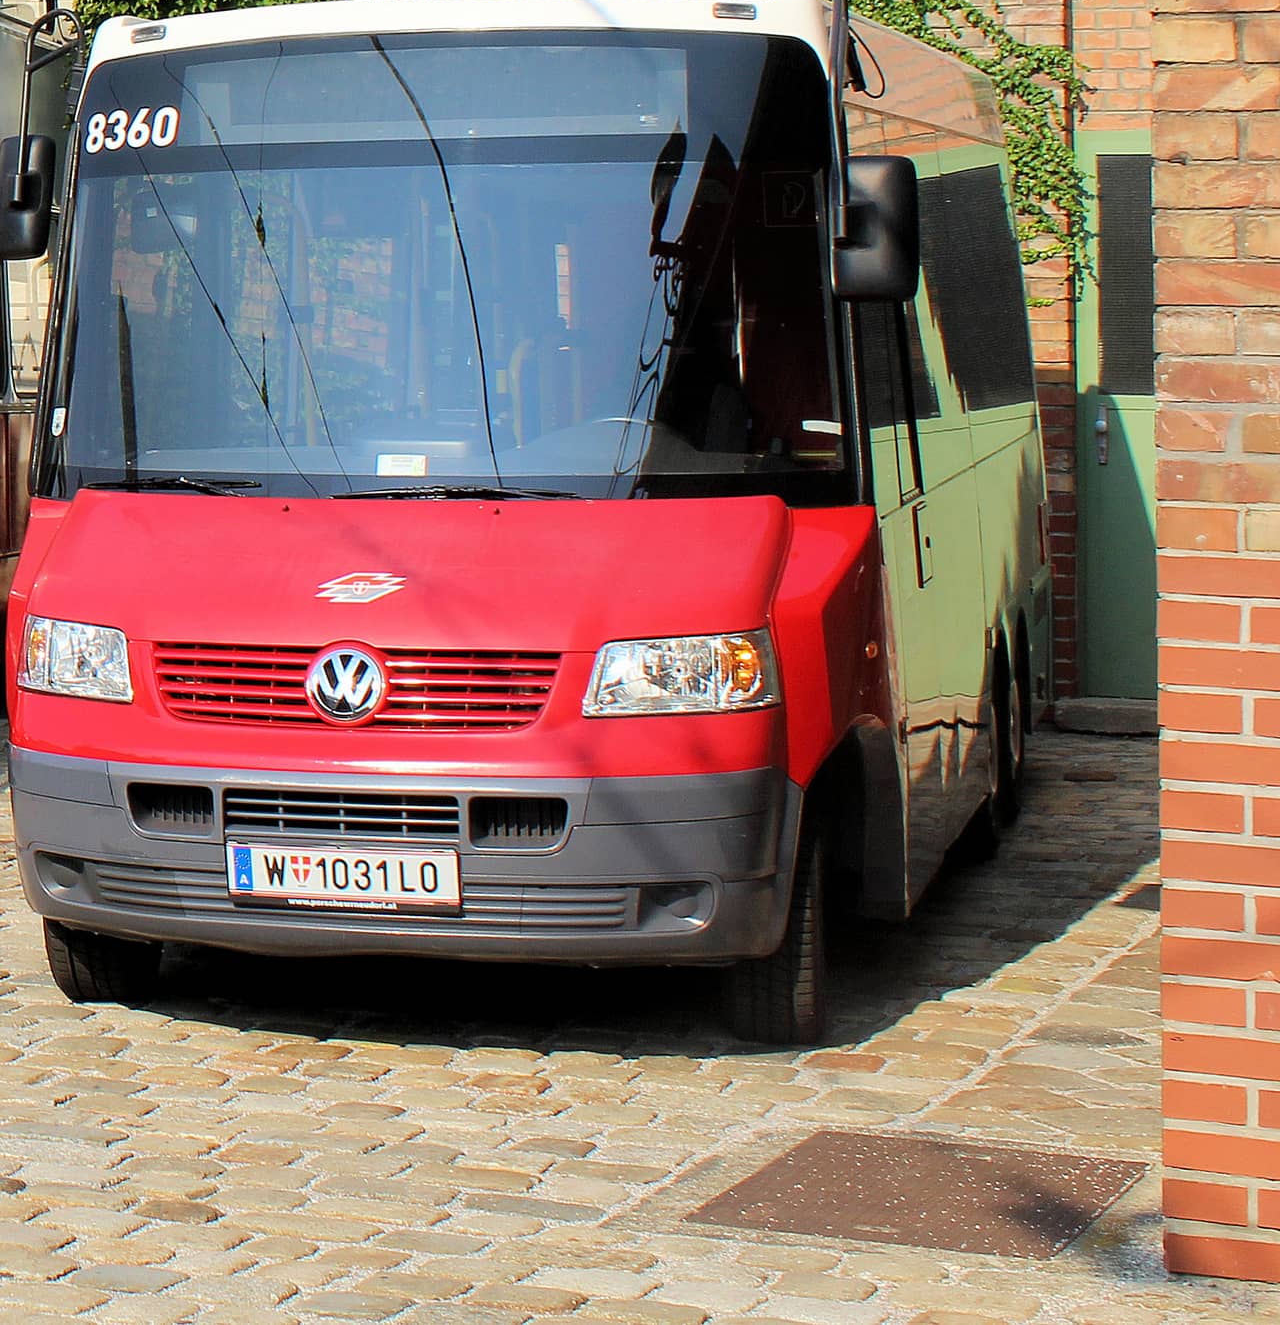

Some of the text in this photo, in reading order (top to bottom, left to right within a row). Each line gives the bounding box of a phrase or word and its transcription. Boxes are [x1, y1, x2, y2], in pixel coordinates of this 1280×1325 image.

[84, 105, 180, 154] 8360
[239, 873, 250, 885] A
[264, 854, 286, 888] W
